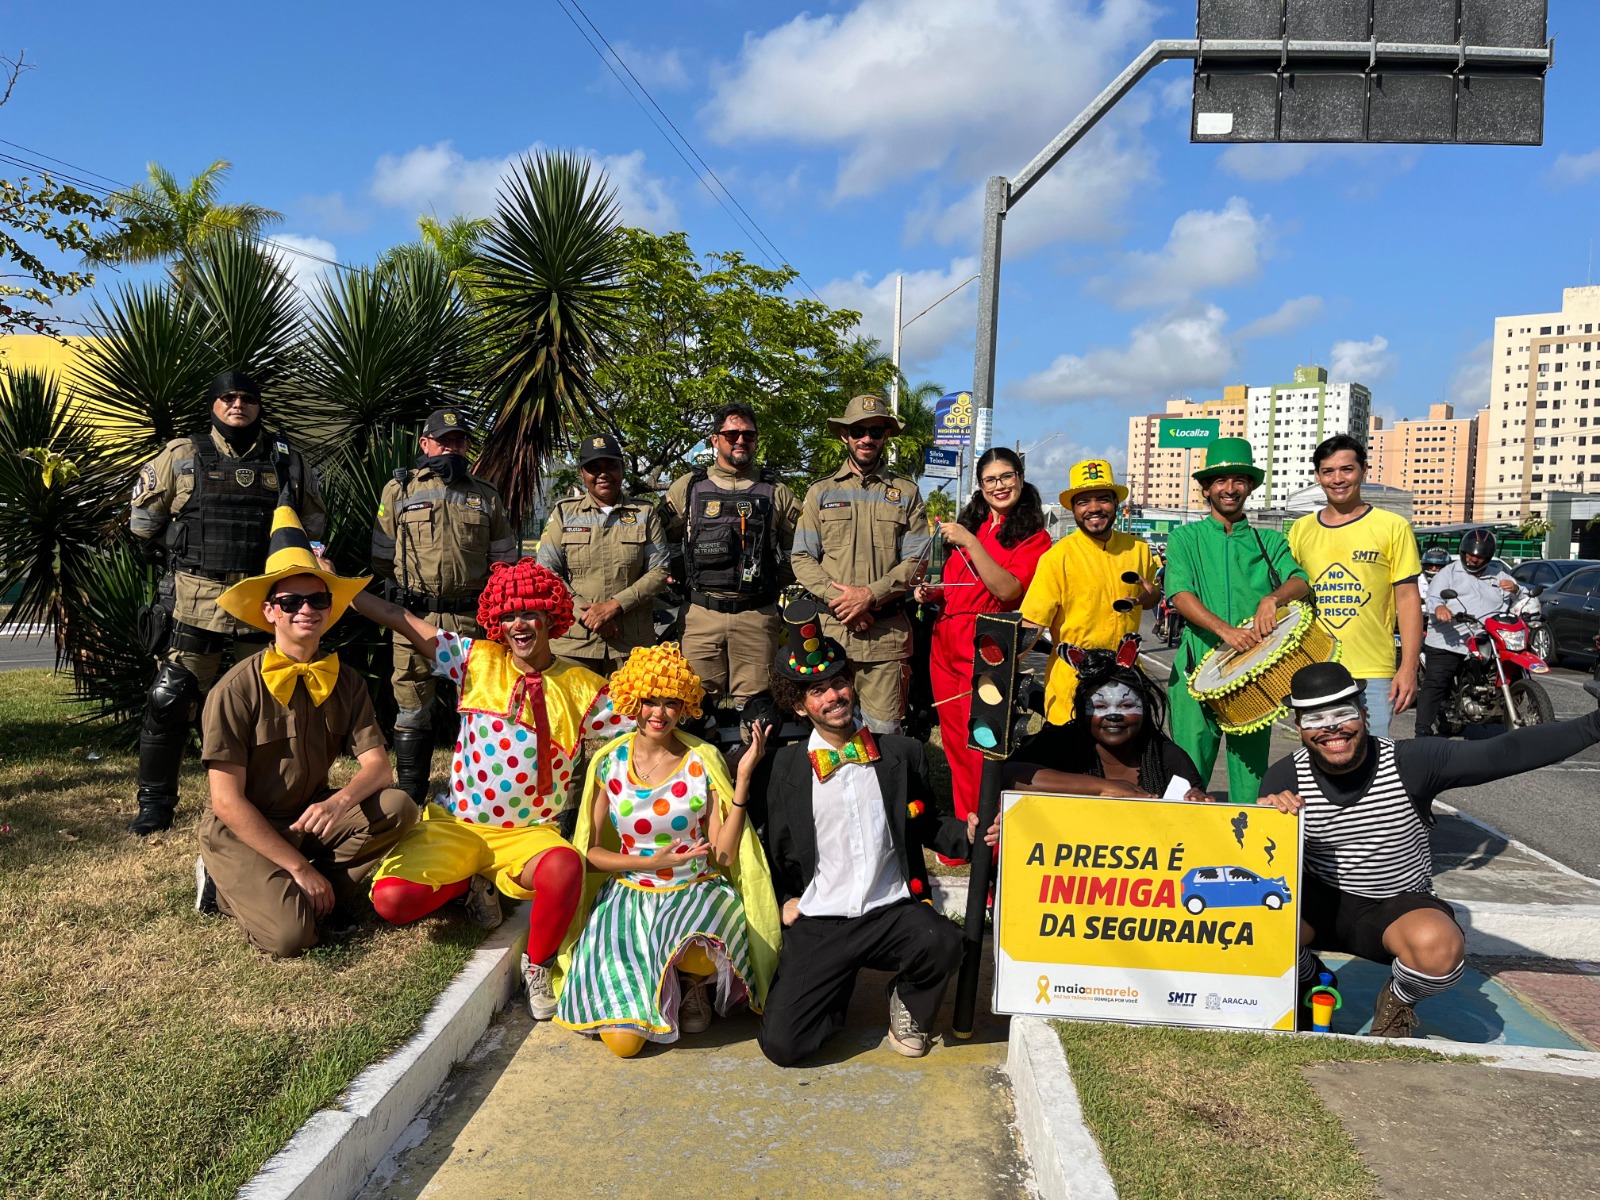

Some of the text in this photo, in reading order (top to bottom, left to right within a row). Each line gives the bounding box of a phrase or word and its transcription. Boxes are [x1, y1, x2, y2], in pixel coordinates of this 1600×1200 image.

[1175, 428, 1210, 437] Localiza
[929, 457, 950, 465] Teixeira
[1352, 550, 1380, 561] SMTT
[1328, 571, 1344, 579] NO
[1312, 581, 1365, 592] TRÂNSITO,
[1315, 595, 1361, 604] PERCEBA
[1324, 608, 1360, 616] RISCO.
[1026, 843, 1185, 871] A PRESSA É
[1038, 875, 1176, 908] INIMIGA
[1039, 913, 1254, 950] DA SEGURANÇA
[1167, 991, 1197, 1004] SMTT
[1222, 997, 1258, 1005] ARACAJU
